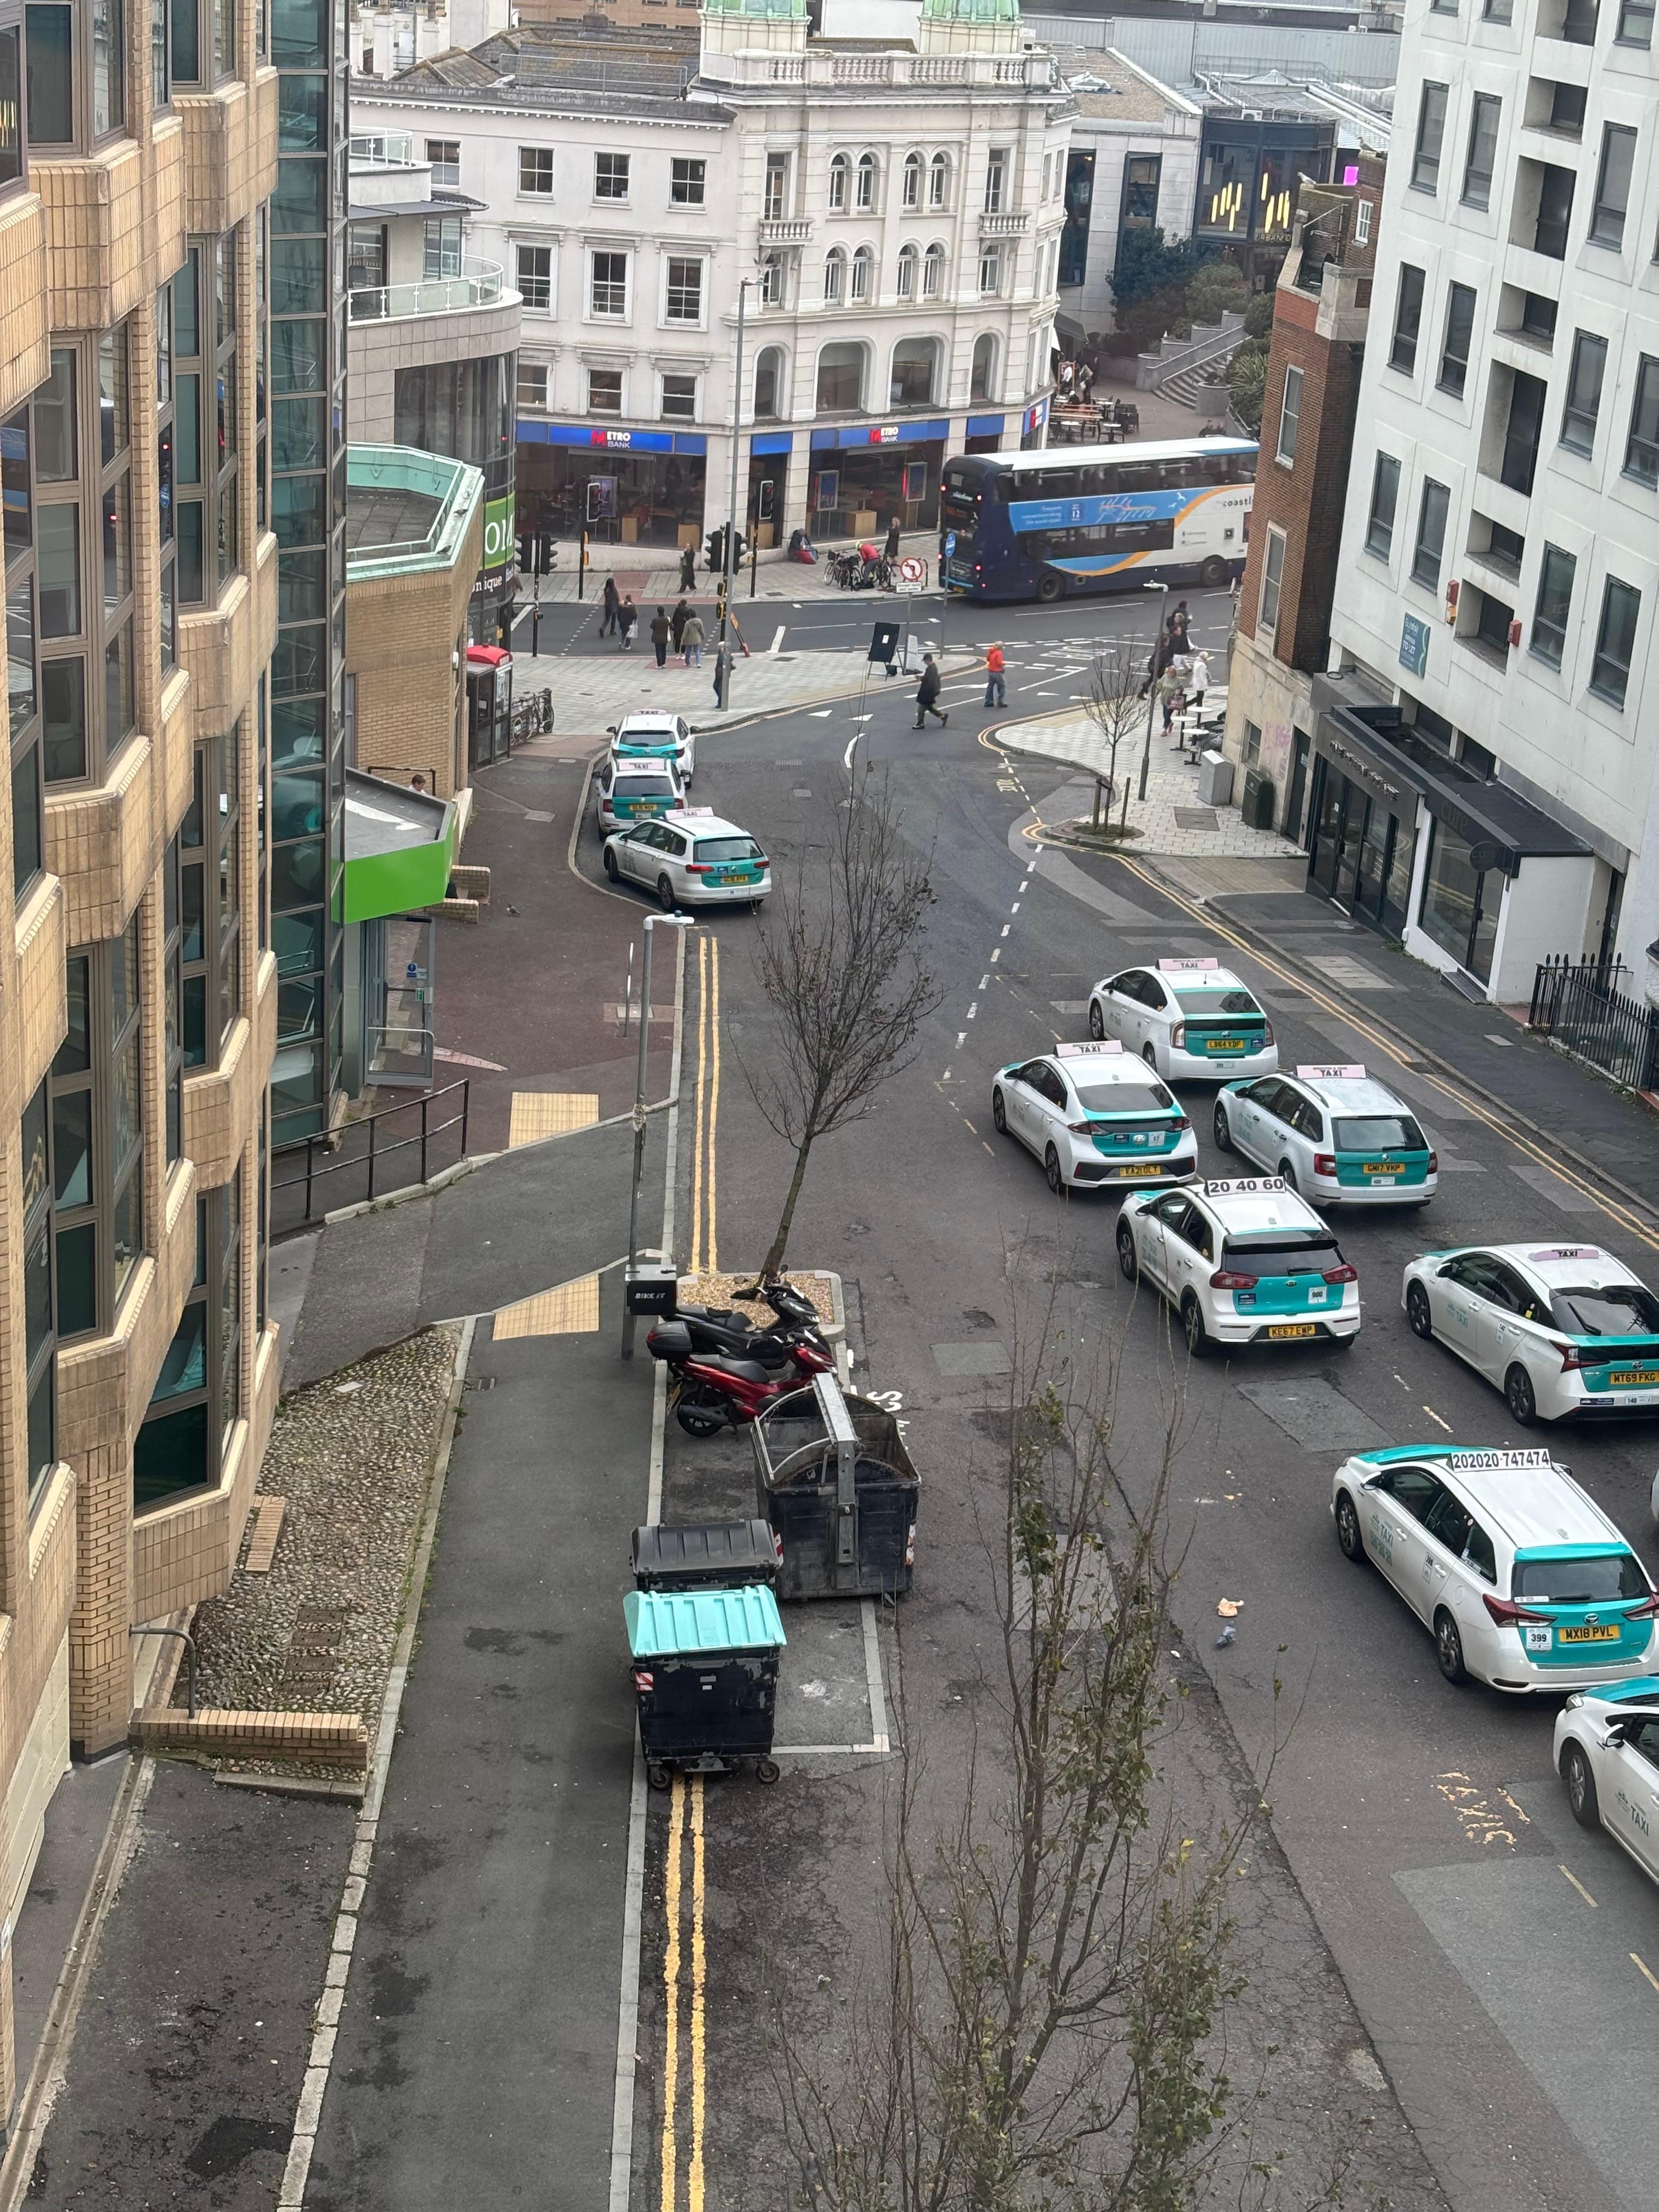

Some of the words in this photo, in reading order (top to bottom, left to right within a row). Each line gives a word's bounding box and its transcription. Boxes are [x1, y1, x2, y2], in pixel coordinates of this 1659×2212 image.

[591, 430, 631, 447] METRO
[607, 441, 630, 449] BANK
[1222, 496, 1252, 507] coastl
[1071, 510, 1080, 518] 12
[1209, 1181, 1230, 1193] 20
[1236, 1180, 1257, 1191] 40
[1262, 1178, 1284, 1190] 60
[1272, 1327, 1295, 1336] KE67
[1639, 1373, 1656, 1382] FKG
[1453, 1450, 1549, 1469] 202020-747474
[1381, 1524, 1393, 1548] TAXI
[1593, 1626, 1613, 1637] PVL
[1531, 1634, 1547, 1643] 399
[1630, 1804, 1649, 1837] TAXI
